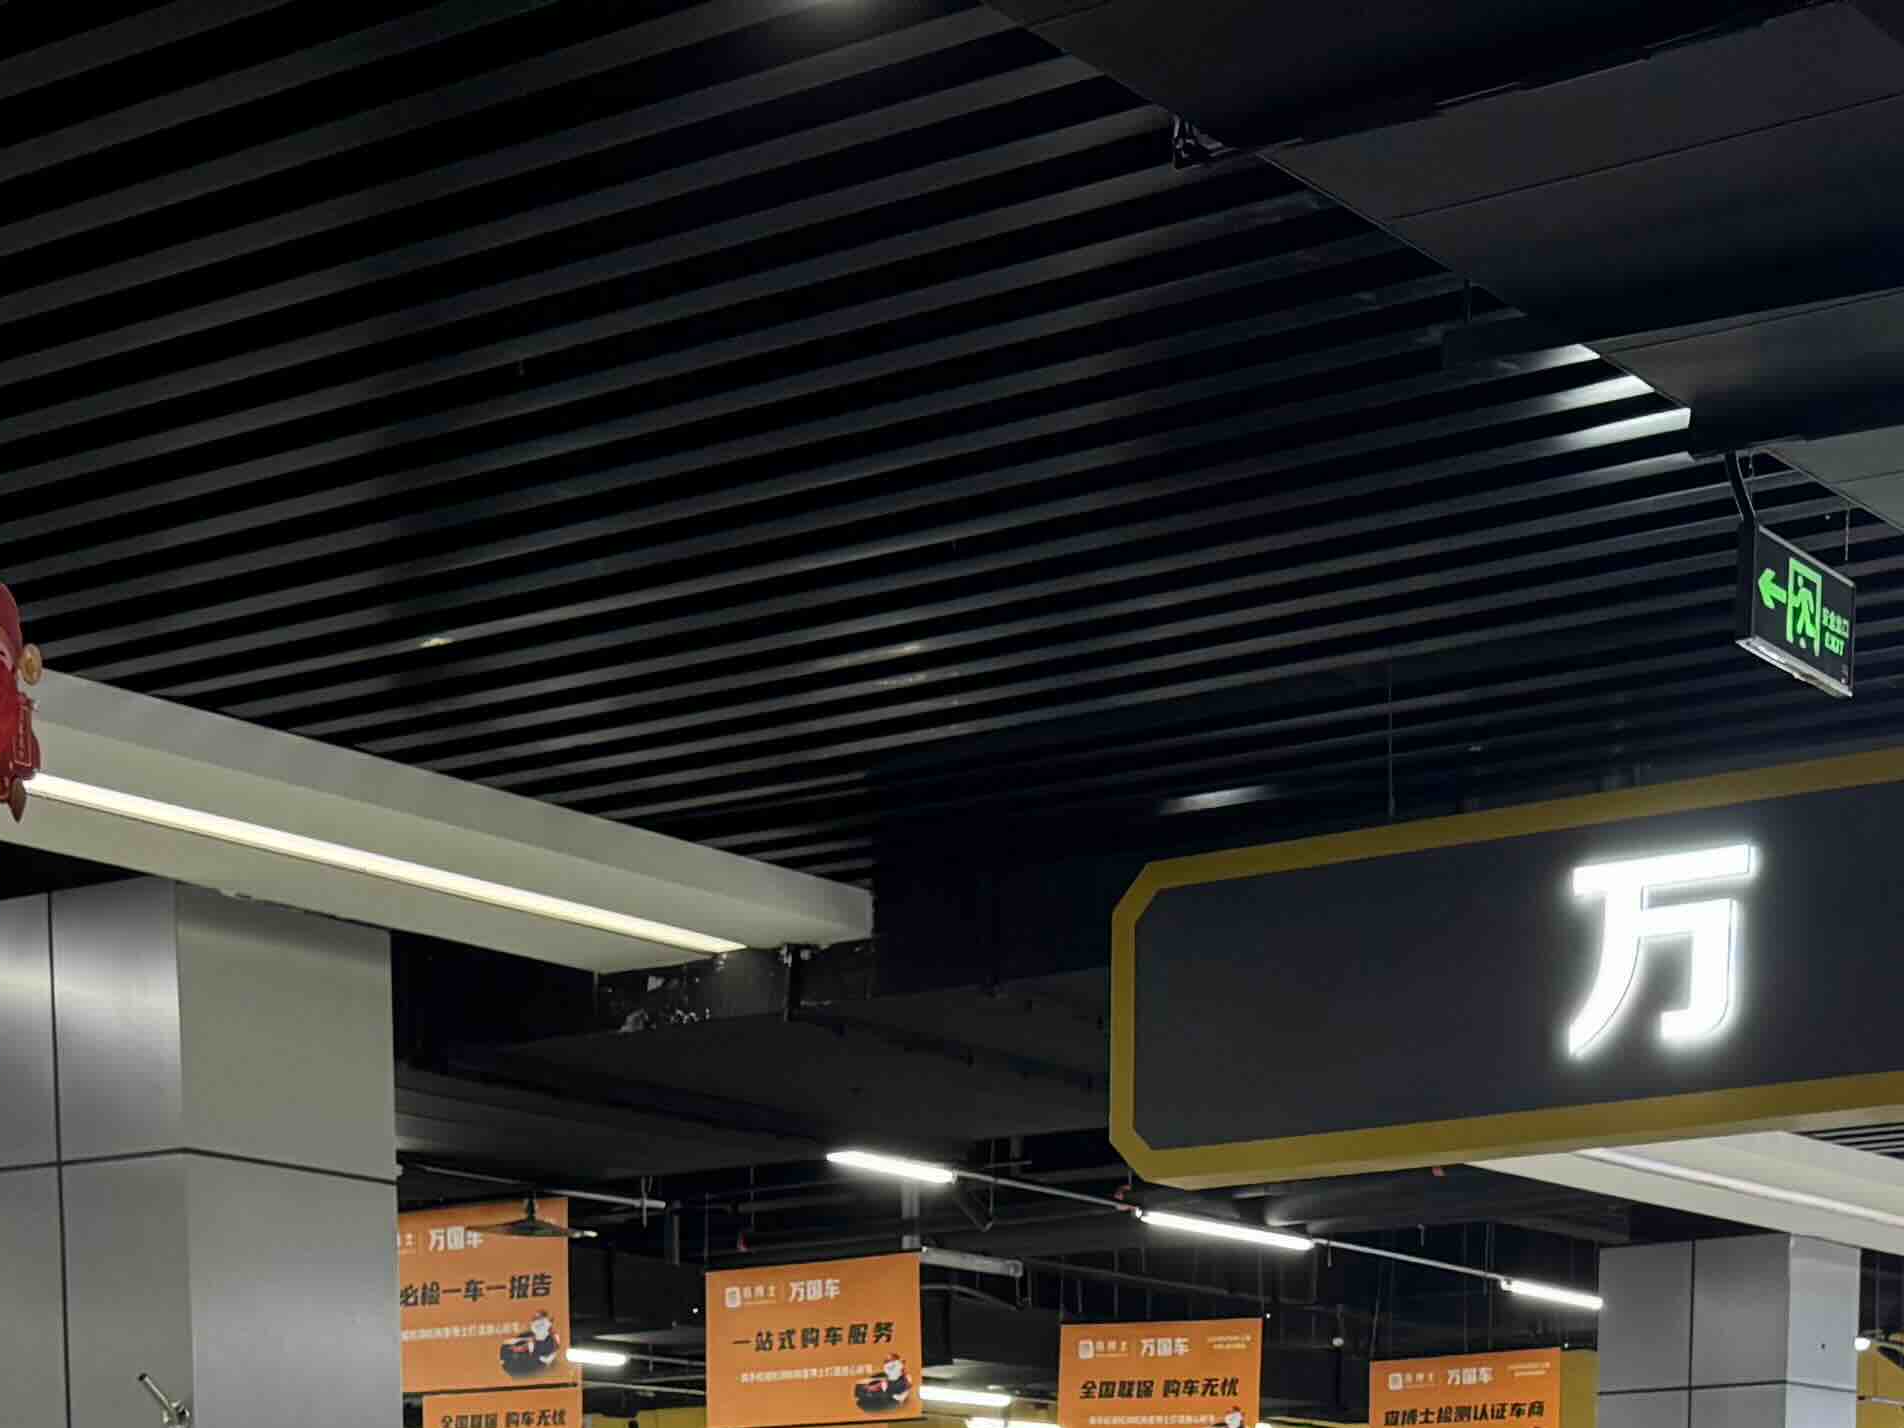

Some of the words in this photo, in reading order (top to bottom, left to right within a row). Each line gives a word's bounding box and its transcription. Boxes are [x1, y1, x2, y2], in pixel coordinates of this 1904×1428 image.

[1824, 631, 1846, 656] EXIT
[733, 1321, 894, 1352] 一站式购车服务
